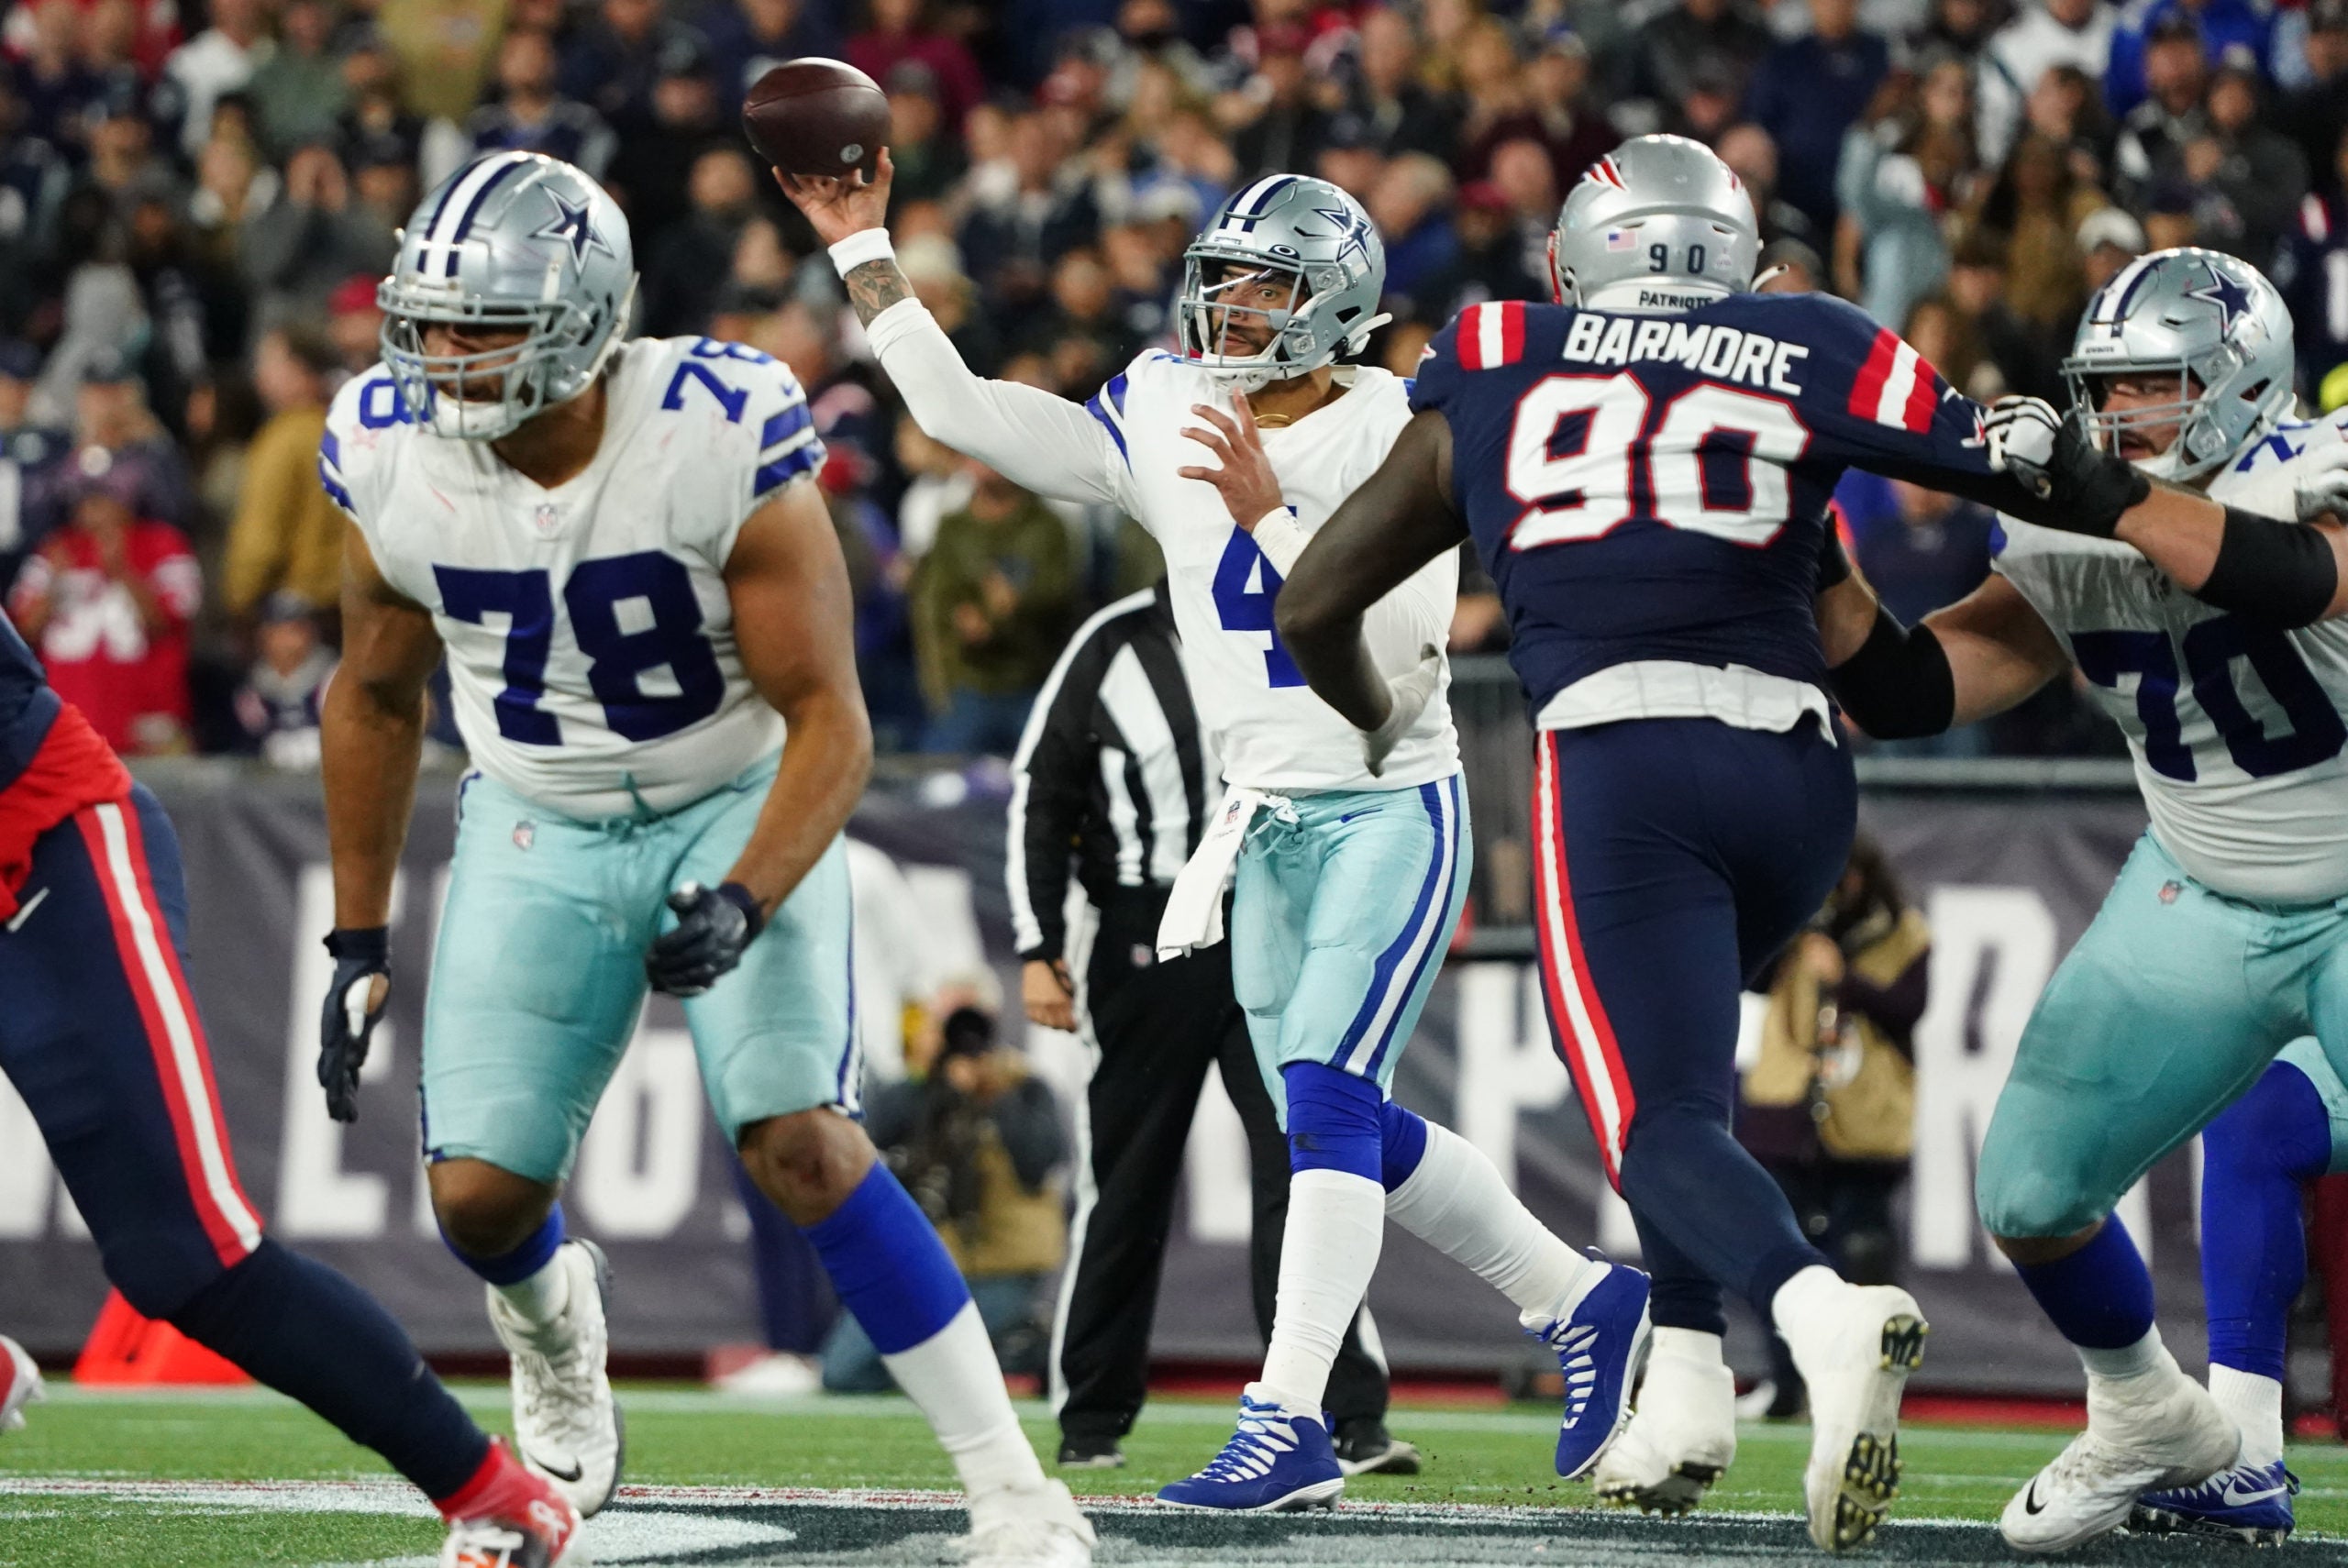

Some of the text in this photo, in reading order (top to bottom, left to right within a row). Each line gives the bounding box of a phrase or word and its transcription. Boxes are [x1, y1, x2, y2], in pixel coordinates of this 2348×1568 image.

[1649, 243, 1705, 274] 90
[1562, 313, 1810, 396] BARMORE
[1506, 369, 1813, 552] 90
[432, 549, 726, 745] 78
[1212, 505, 1309, 688] 4
[2068, 613, 2348, 782] 70
